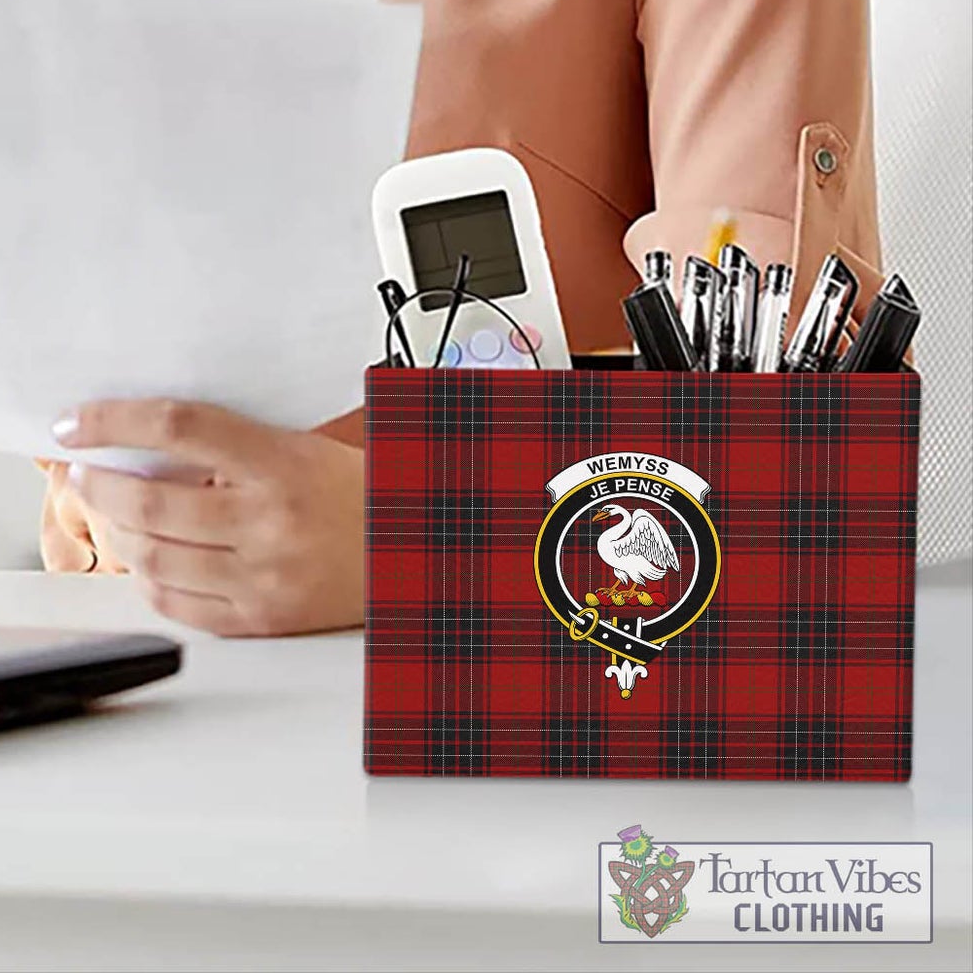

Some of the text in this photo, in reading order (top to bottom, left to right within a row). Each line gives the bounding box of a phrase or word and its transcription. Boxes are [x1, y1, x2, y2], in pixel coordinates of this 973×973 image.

[587, 456, 669, 475] WEMYSS
[589, 479, 675, 502] JE PENSE
